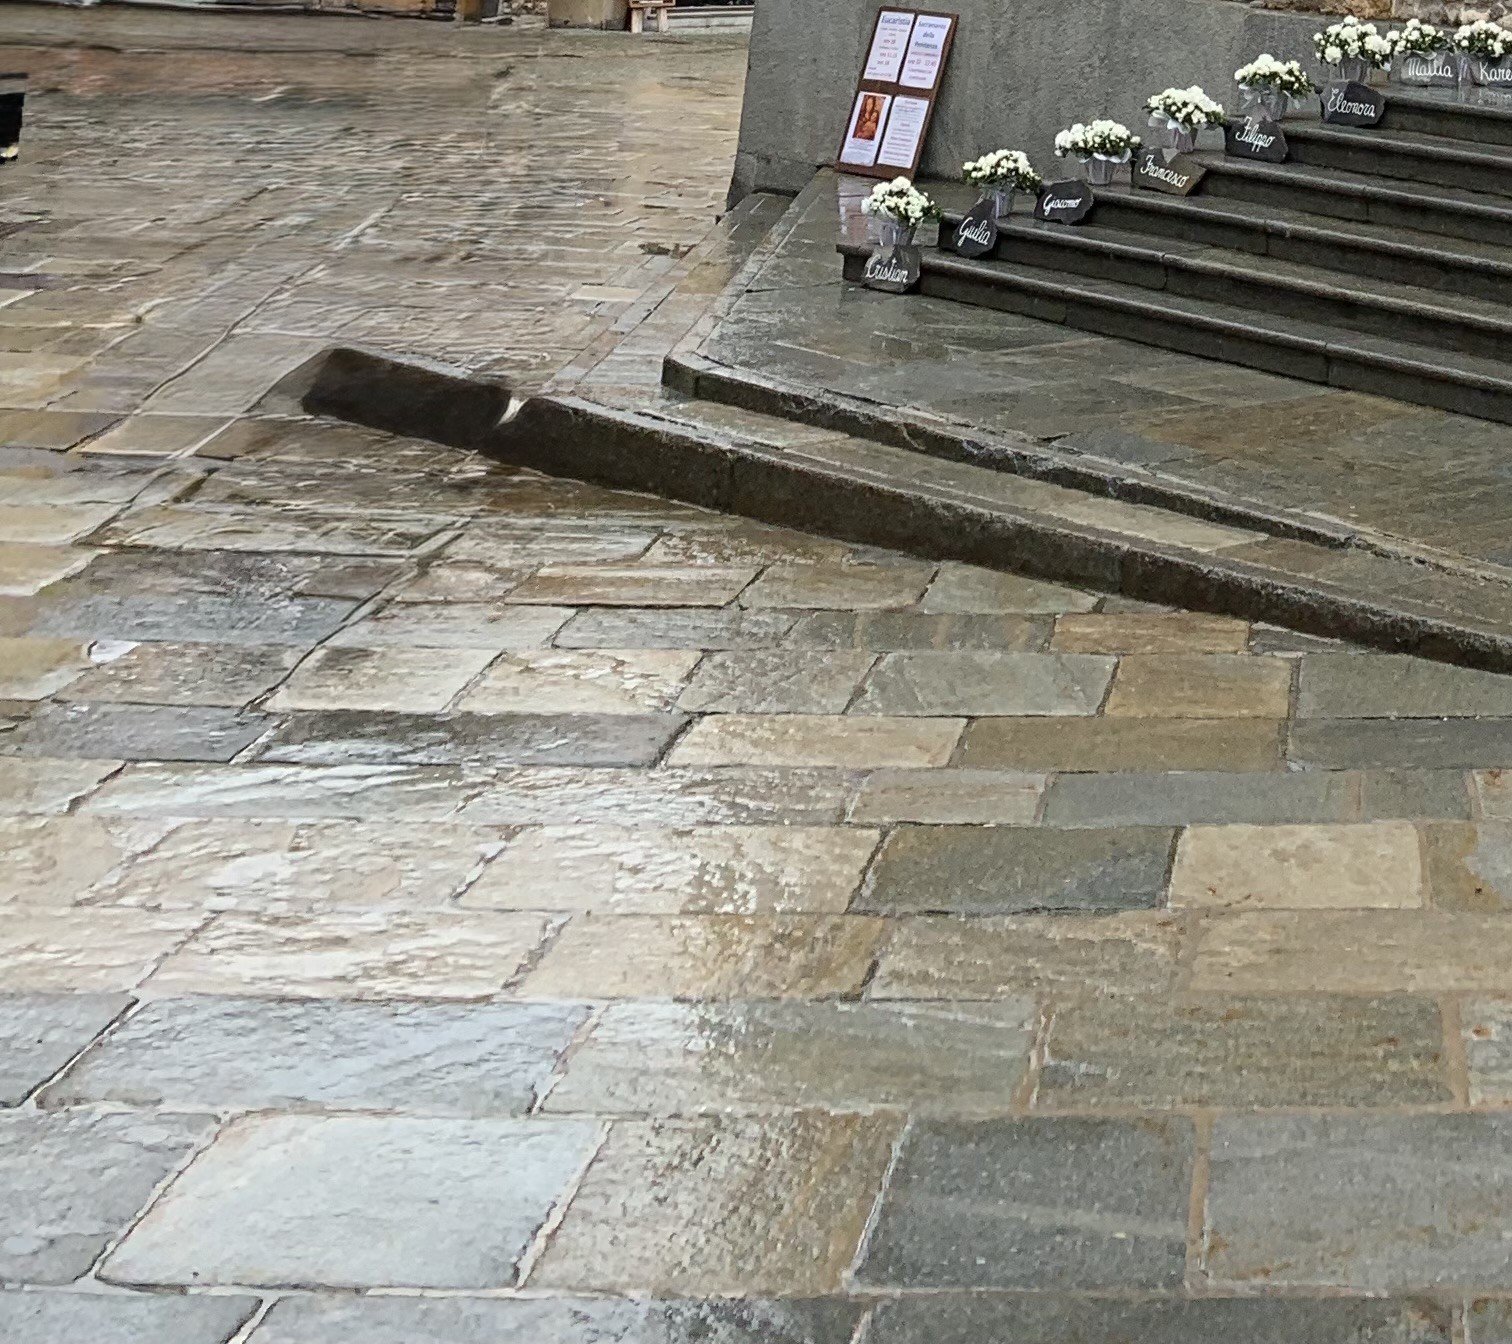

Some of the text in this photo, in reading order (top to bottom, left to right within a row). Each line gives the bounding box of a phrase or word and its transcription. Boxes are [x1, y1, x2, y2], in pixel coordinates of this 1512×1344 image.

[1406, 56, 1454, 78] Mattia
[1327, 87, 1375, 118] Eleonora
[1235, 115, 1276, 153] Filippo
[1140, 154, 1190, 188] Francesco
[1043, 193, 1082, 216] Giacomo
[957, 216, 992, 247] Giulia
[865, 253, 908, 283] Cristian
